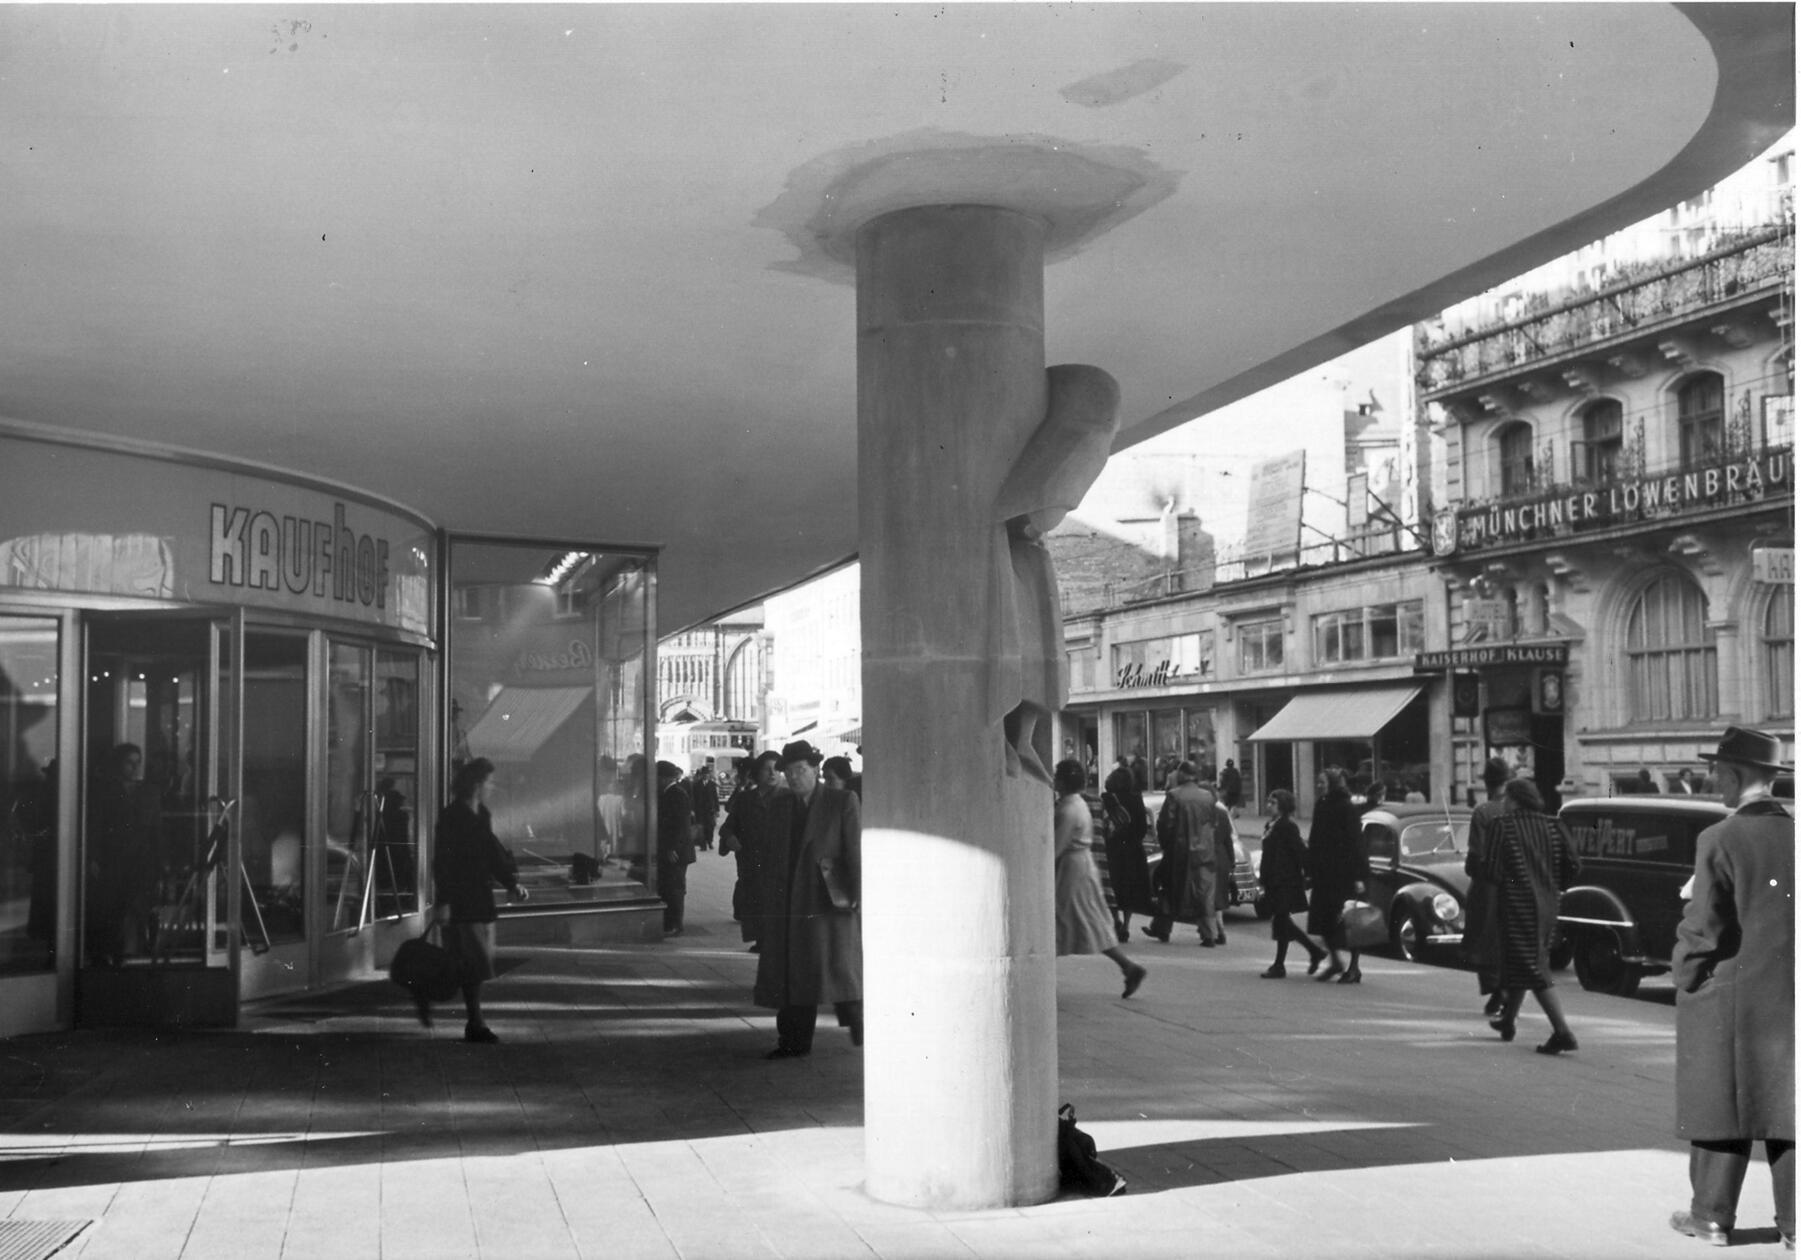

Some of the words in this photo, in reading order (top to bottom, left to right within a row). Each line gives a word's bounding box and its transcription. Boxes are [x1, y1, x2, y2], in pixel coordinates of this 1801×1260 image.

[1472, 492, 1596, 539] MÜNCHNER
[1609, 457, 1785, 516] LÖWENBRÄU
[1421, 648, 1497, 667] KAISERHOF
[1506, 647, 1564, 662] KLAUSE
